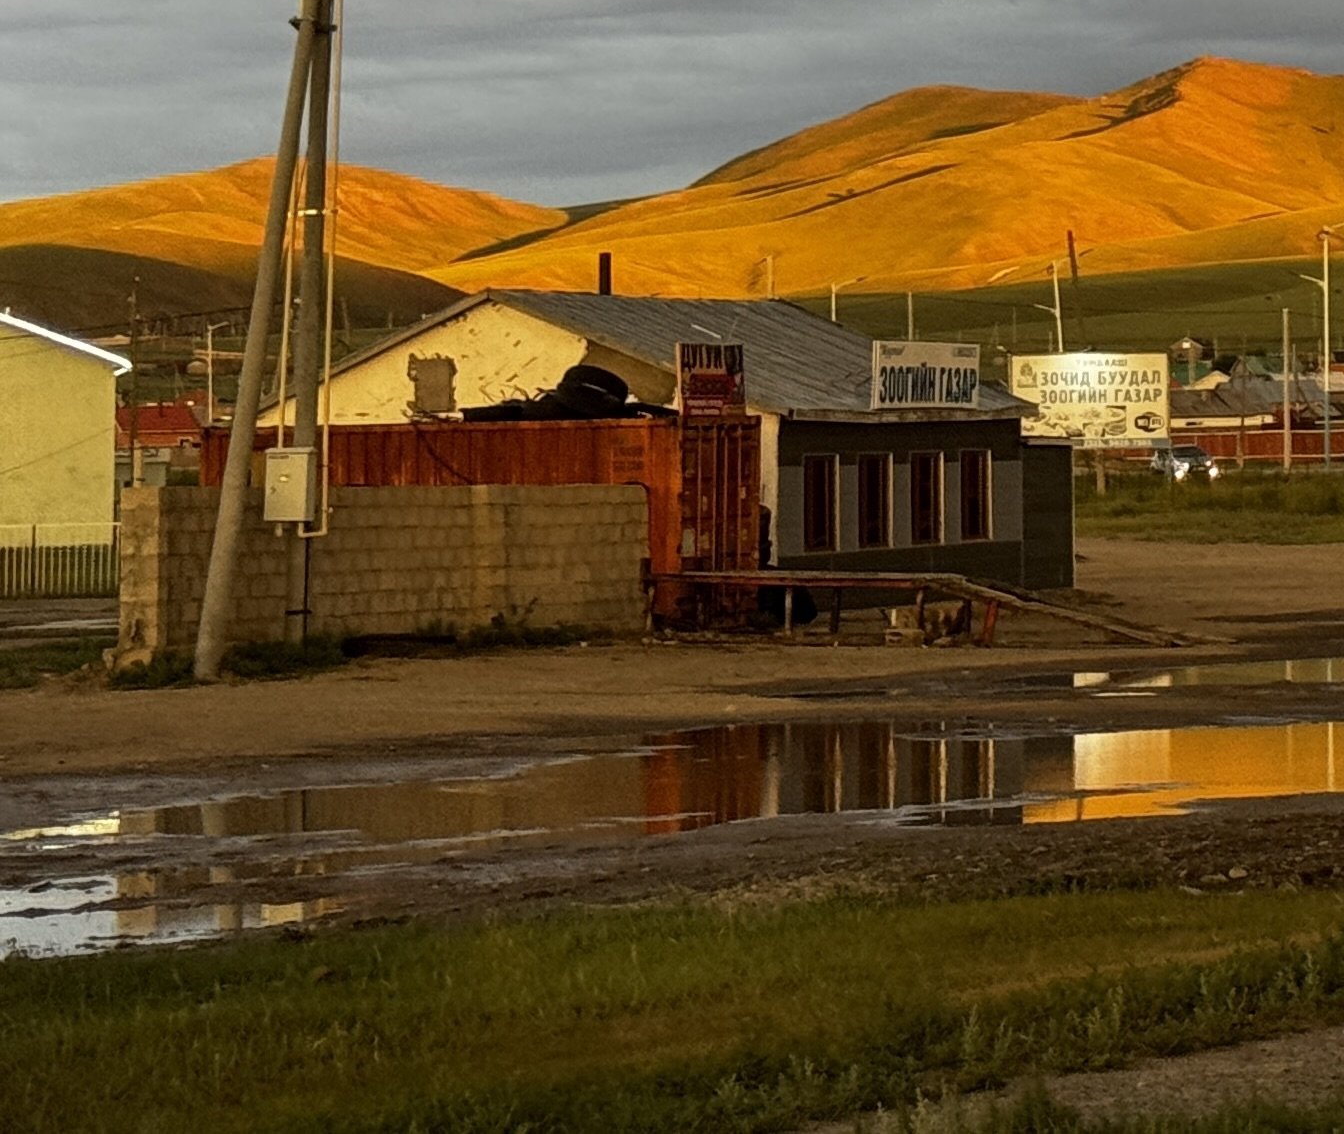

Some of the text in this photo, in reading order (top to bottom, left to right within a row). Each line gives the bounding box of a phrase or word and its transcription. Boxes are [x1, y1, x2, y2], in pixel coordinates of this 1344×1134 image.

[880, 362, 978, 403] ЗООГИЙН ГАЗАР
[1040, 370, 1162, 387] ЗОЧИД БУУДАЛ
[1040, 387, 1164, 404] ЗООГИЙН ГАЗАР
